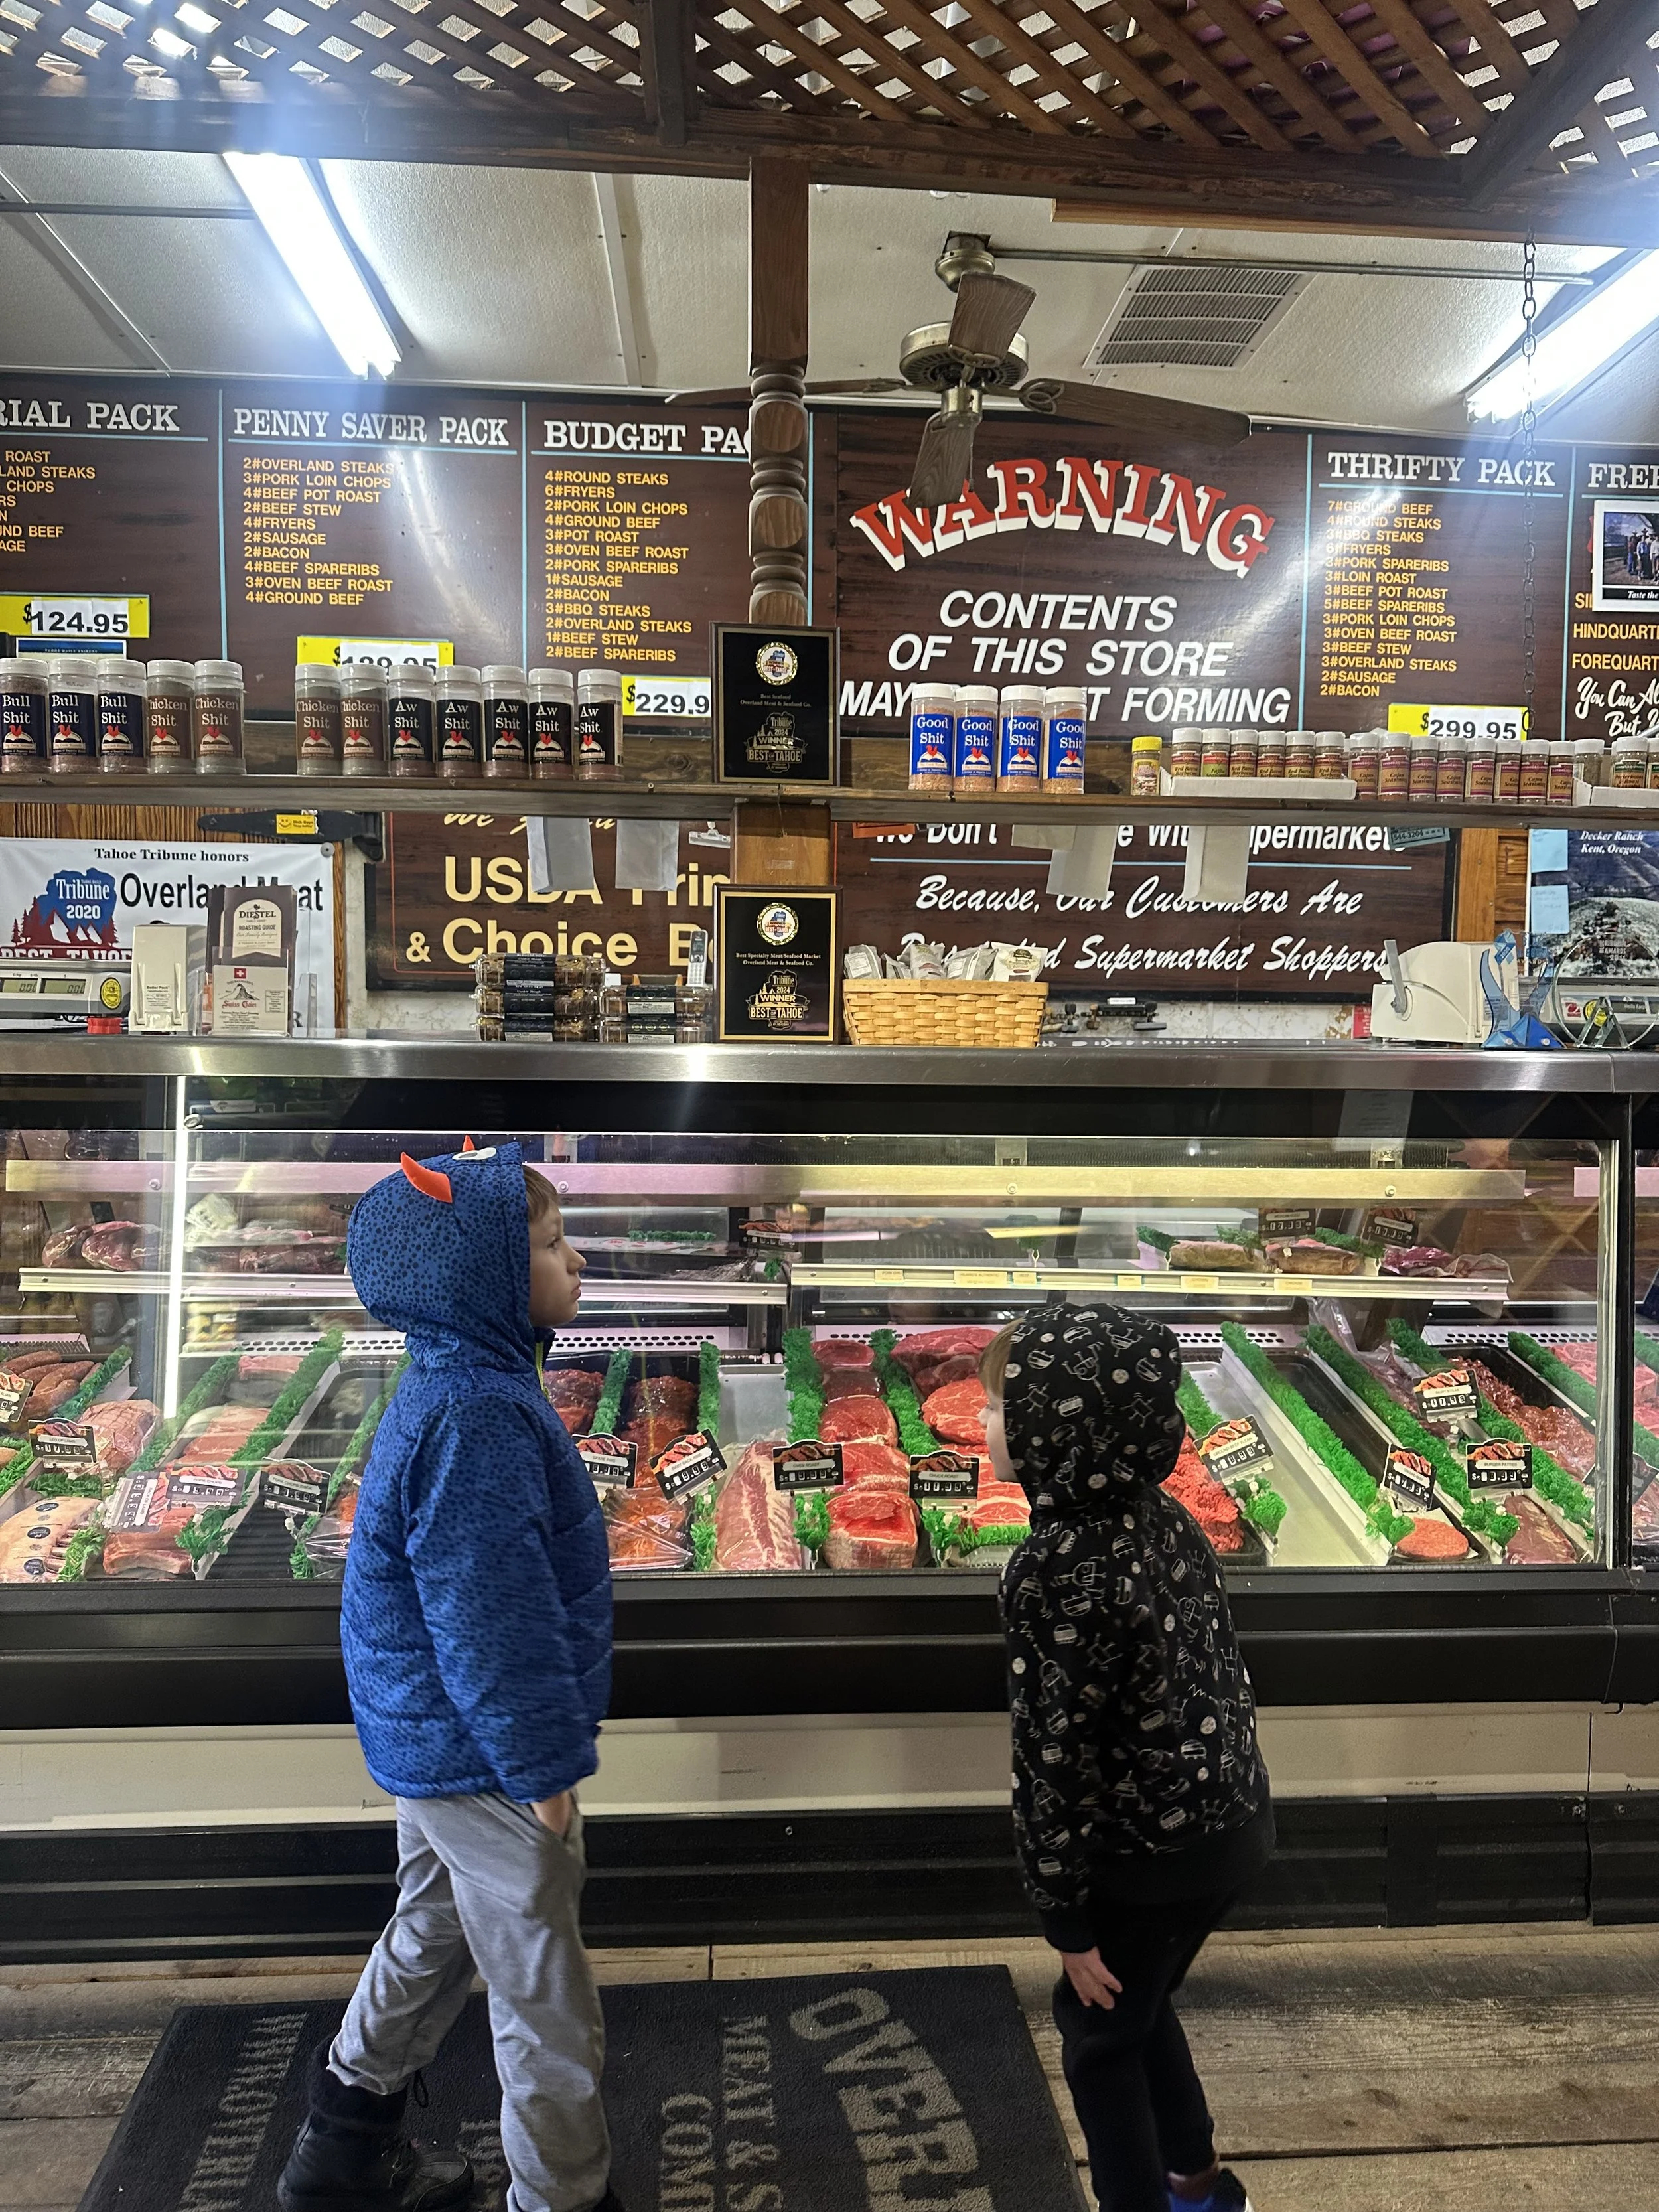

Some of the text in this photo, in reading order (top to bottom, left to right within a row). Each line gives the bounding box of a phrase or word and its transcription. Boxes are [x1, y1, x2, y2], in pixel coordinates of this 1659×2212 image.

[87, 403, 179, 431] PACK
[234, 409, 509, 445] PENNY SAVER PACK
[544, 421, 685, 451] BUDGET
[6, 451, 50, 462] ROAST
[42, 467, 95, 479] STEAKS
[244, 458, 396, 474] 2#OVERLAND STEAKS
[1327, 451, 1556, 487] THRIFTY PACK
[244, 472, 392, 489] 3#PORK LOIN CHOPS
[545, 471, 668, 485] 4#ROUND STEAKS
[7, 480, 54, 492] CHOPS
[545, 484, 614, 498] 6#FRYERS
[244, 487, 381, 502] 4#BEEF POT ROAST
[244, 502, 341, 516] 2#BEEF STEW
[545, 500, 687, 515] 2#PORK LOIN CHOPS
[244, 517, 315, 530] 4#FRYERS
[545, 514, 660, 528] 4#GROUND BEEF
[850, 457, 1275, 579] WARNING
[29, 526, 63, 537] BEEF
[244, 531, 326, 545] 2#SAUSAGE
[545, 529, 639, 542] 3#POT ROAST
[244, 546, 309, 559] 2#BACON
[545, 544, 689, 558] 3#OVEN BEEF ROAST
[244, 561, 379, 576] 4#BEEF SPARERIBS
[546, 559, 678, 574] 2#PORK SPARERIBS
[246, 576, 393, 591] 3#OVEN BEEF ROAST
[546, 573, 622, 587] 1#SAUSAGE
[1325, 571, 1417, 584] 3#LOIN ROAST
[246, 591, 364, 605] 4#GROUND BEEF
[546, 588, 609, 601] 2#BACON
[1325, 584, 1448, 599] 3#BEEF POT ROAST
[1627, 591, 1659, 599] Taste the
[546, 603, 650, 617] 3#BBQ STEAKS
[940, 591, 1177, 632] CONTENTS
[1324, 599, 1445, 613] 5#BEEF SPARERIBS
[23, 603, 128, 633] $124.95
[546, 617, 691, 632] 2#OVERLAND STEAKS
[1323, 613, 1455, 627] 3#PORK LOIN CHOPS
[546, 632, 638, 645] 1#BEEF STEW
[1324, 627, 1457, 642] 3#OVEN BEEF ROAST
[1573, 623, 1659, 640] HINDQUART
[546, 646, 676, 661] 2#BEEF SPARERIBS
[889, 634, 1236, 676] OF THIS STORE
[1323, 642, 1411, 654] 3#BEEF STEW
[1322, 656, 1456, 672] 3#OVERLAND STEAKS
[1322, 670, 1396, 683] 2#SAUSAGE
[1321, 684, 1379, 696] 2#BACON
[100, 696, 127, 707] Bull
[195, 697, 239, 710] Chicken
[839, 680, 916, 717] MAY
[1123, 687, 1292, 724] FORMING
[1575, 676, 1636, 719] You Can
[296, 700, 340, 713] Chicken
[536, 705, 558, 717] Aw
[580, 706, 599, 718] Aw
[101, 713, 127, 725] Shit
[202, 713, 229, 726] Shit
[303, 716, 330, 729] Shit
[770, 717, 792, 728] Tribune
[916, 716, 948, 729] Good
[1421, 713, 1516, 739] $299.95
[535, 720, 559, 733] Shit
[580, 721, 601, 733] Shit
[1056, 721, 1084, 733] Good
[758, 737, 794, 745] WINNER
[920, 732, 945, 744] Shit
[1060, 737, 1082, 749] Shit
[749, 749, 800, 761] BEST TAHOE
[1580, 830, 1644, 842] Decker Ranch
[94, 848, 249, 863] Tahoe Tribune honors
[1581, 844, 1642, 855] Kent, Oregon
[56, 879, 110, 901] Tribune
[916, 875, 1040, 914] Because,
[1299, 879, 1364, 916] Are
[66, 904, 101, 920] 2020
[238, 910, 277, 919] DIESTEL
[406, 917, 638, 967] & Choice
[1074, 934, 1255, 980] Supermarket
[1263, 935, 1387, 981] Shoppers
[772, 975, 794, 986] Tribune
[751, 1007, 803, 1019] BEST TAHOE
[723, 2015, 775, 2126] MEAT
